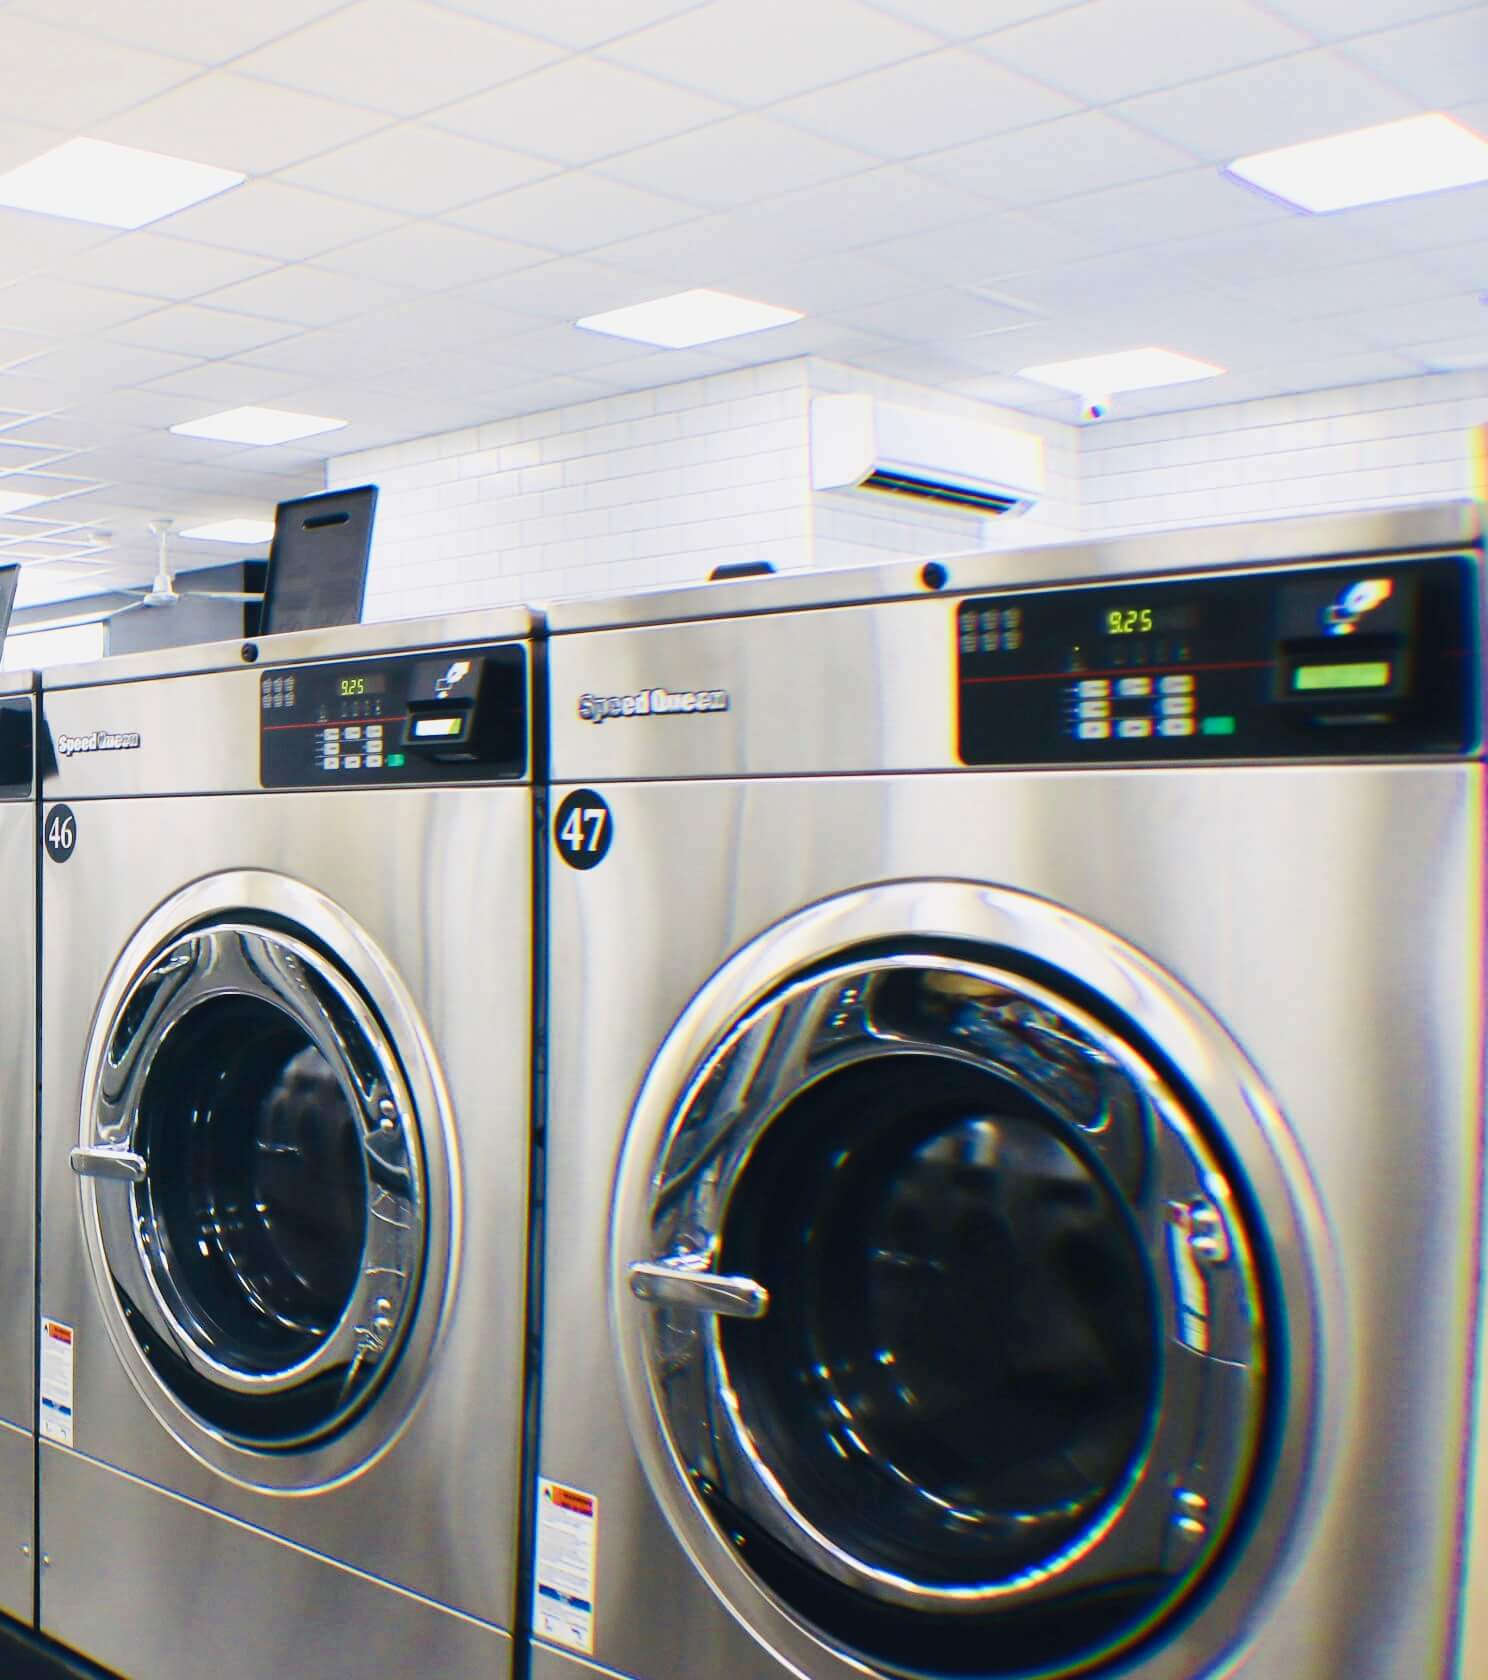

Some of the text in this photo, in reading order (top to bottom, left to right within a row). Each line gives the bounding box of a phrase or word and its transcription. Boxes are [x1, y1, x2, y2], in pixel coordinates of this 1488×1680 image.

[1107, 609, 1152, 635] 9.25
[341, 678, 365, 697] 9.25
[578, 687, 729, 724] Speed Queen
[58, 731, 97, 757] Speed
[48, 815, 73, 849] 46
[560, 807, 608, 852] 47
